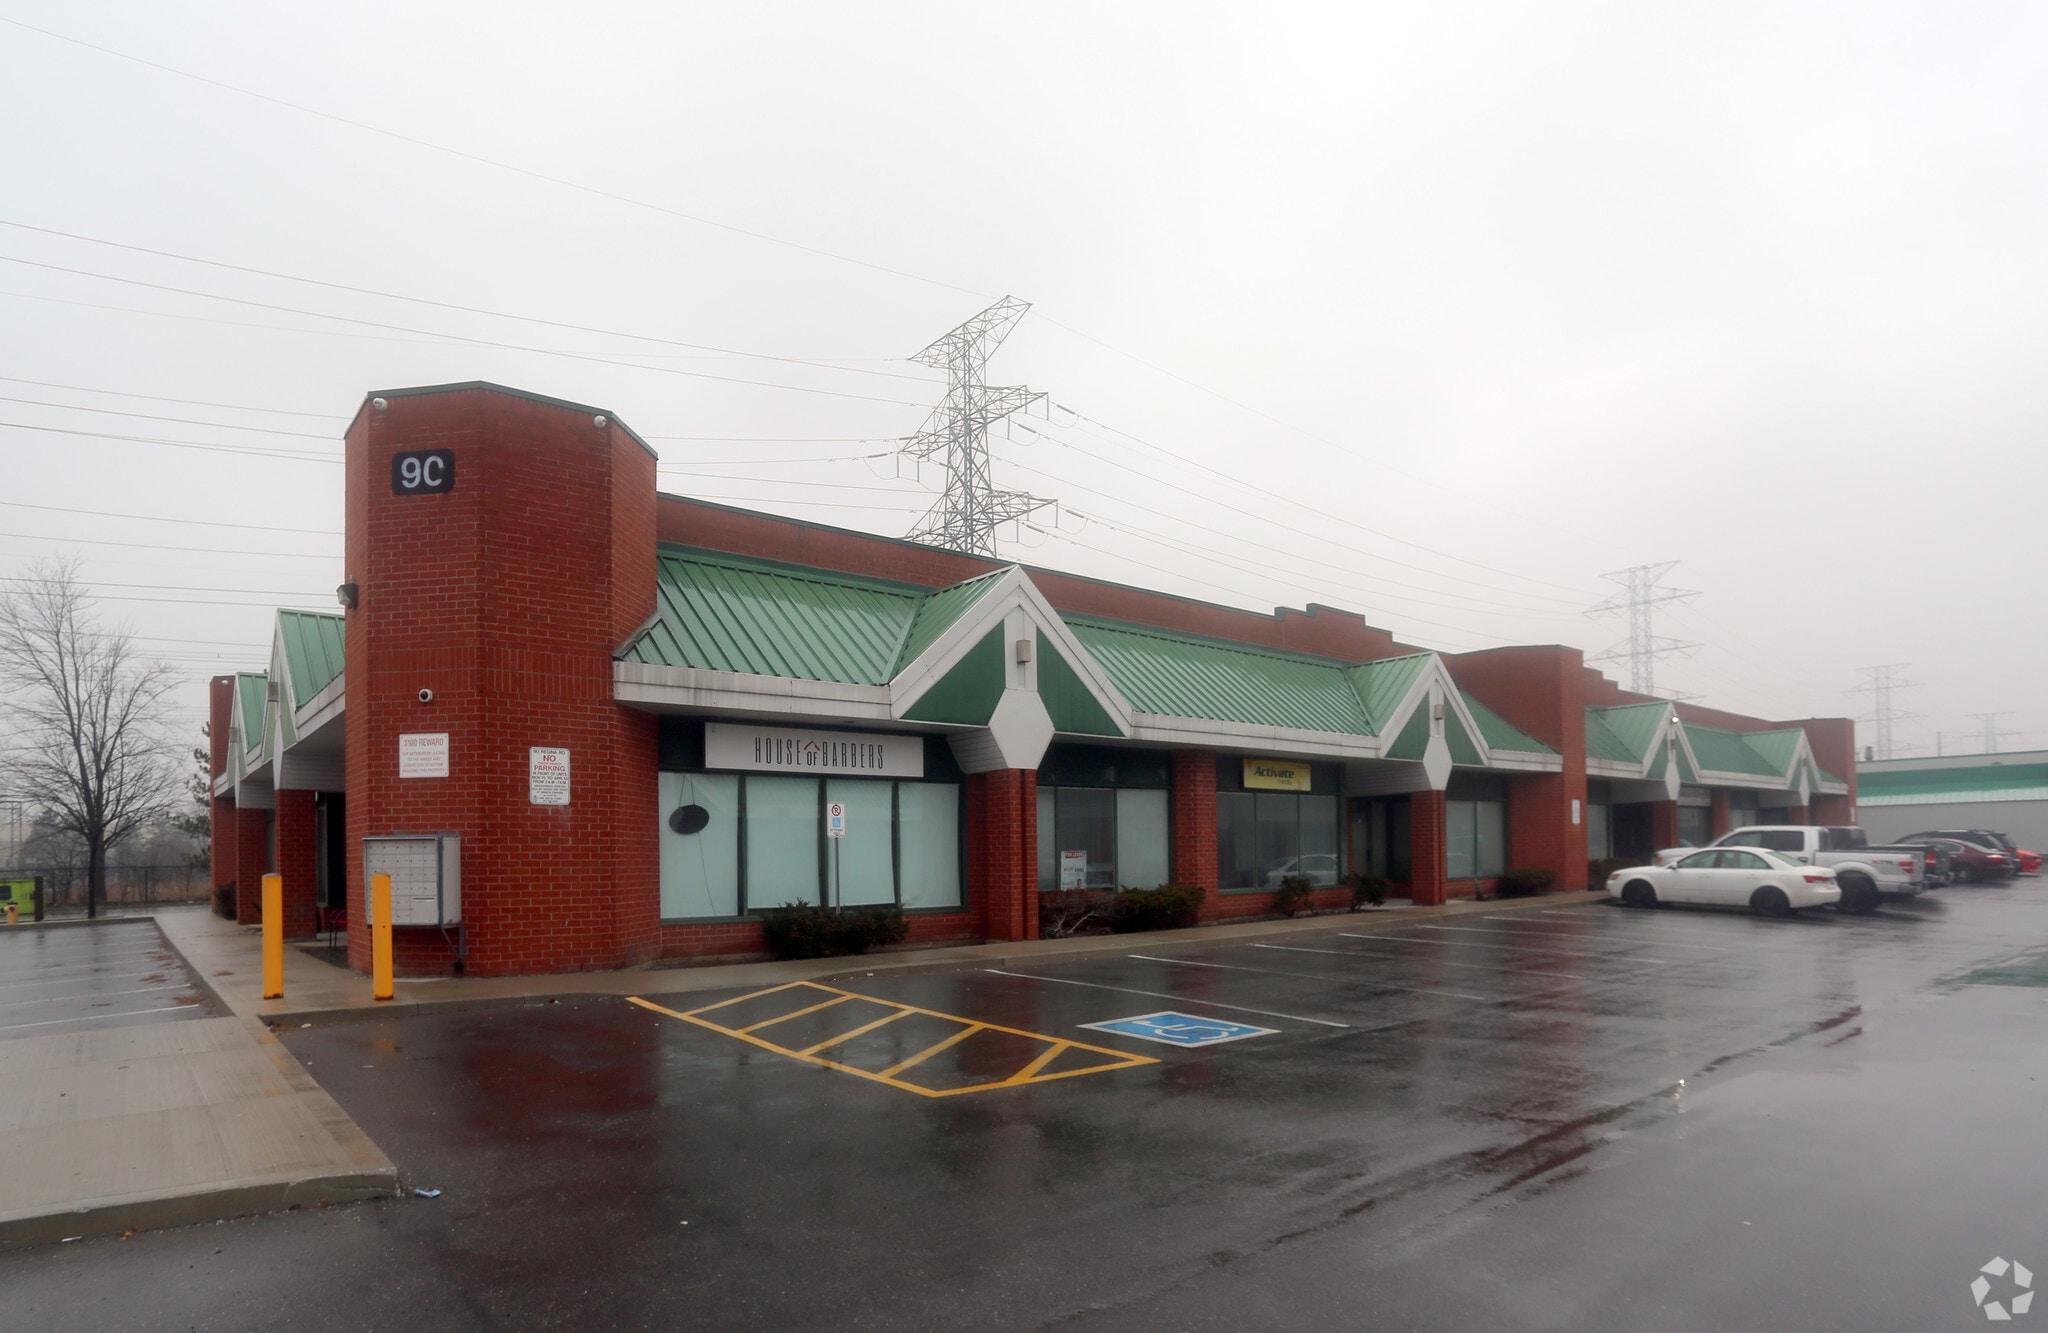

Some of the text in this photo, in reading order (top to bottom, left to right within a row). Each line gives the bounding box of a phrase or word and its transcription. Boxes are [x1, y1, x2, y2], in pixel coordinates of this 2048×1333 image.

[401, 455, 445, 489] 9C
[404, 738, 443, 747] $100 REWARD
[755, 736, 884, 770] HOUSE OF BARBERS
[1254, 767, 1295, 779] Activate
